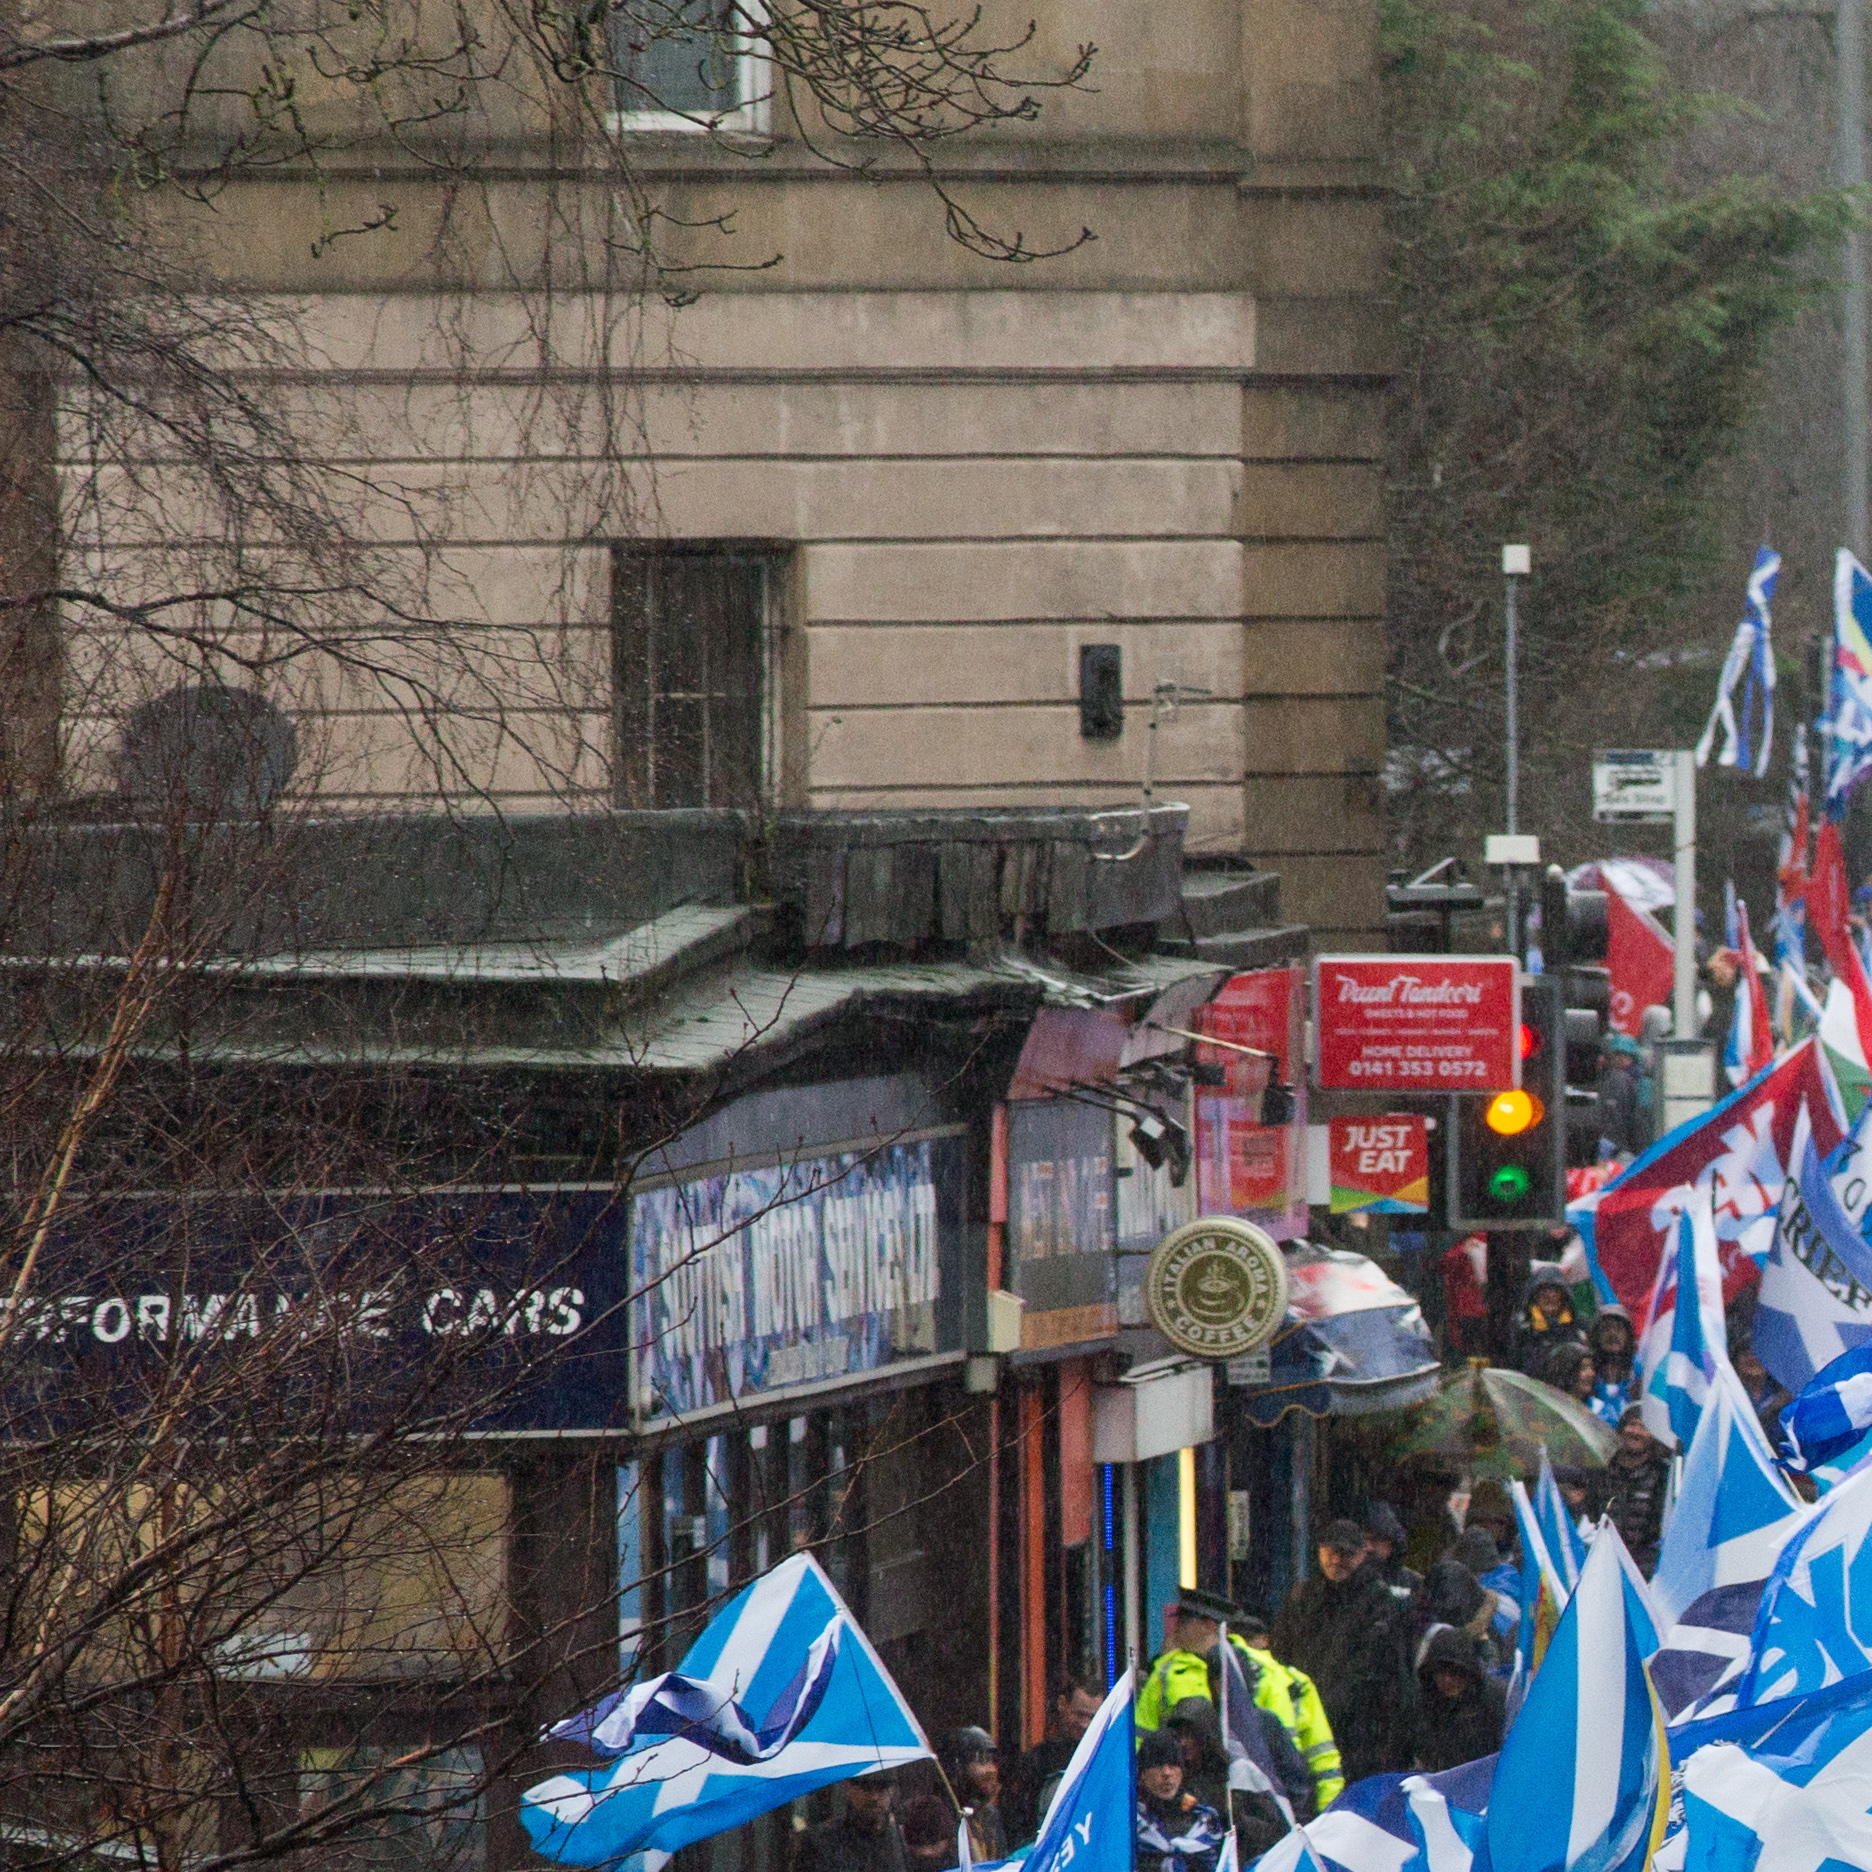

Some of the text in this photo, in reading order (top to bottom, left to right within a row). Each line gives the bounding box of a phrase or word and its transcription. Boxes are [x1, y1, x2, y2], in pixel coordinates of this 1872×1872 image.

[1361, 1046, 1473, 1058] HOME DELIVERY
[1350, 1061, 1487, 1076] 0141 353 0572
[1344, 1126, 1411, 1152] JUST
[1359, 1151, 1412, 1173] EAT
[1164, 1237, 1268, 1294] ITALIAN AROMA
[421, 1288, 583, 1339] CARS
[1176, 1315, 1261, 1344] COFFEE
